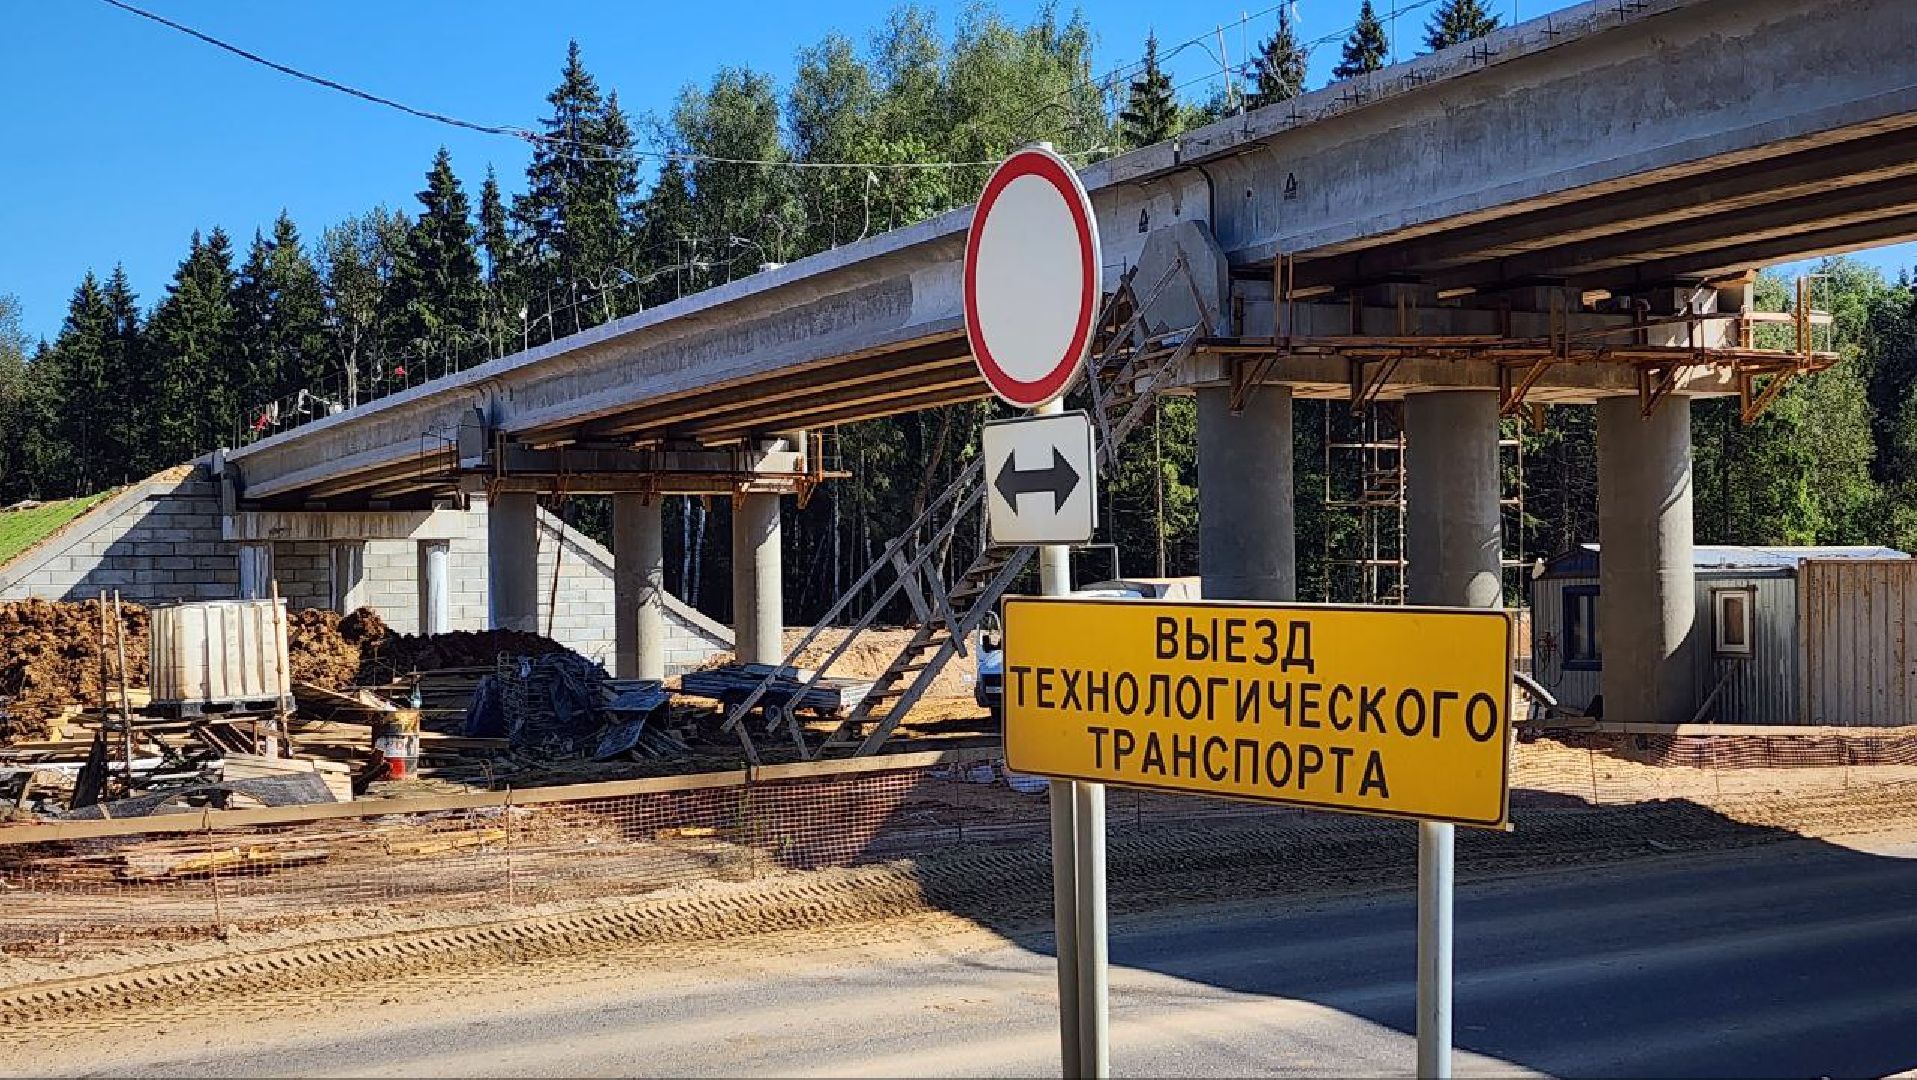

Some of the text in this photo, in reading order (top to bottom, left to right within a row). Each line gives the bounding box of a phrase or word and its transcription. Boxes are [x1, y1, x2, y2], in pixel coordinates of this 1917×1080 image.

[1156, 616, 1315, 675] ВЫЕЗД
[1009, 665, 1498, 743] ТЕХНОЛОГИЧЕСКОГО
[1087, 726, 1390, 799] ТРАНСПОРТА
